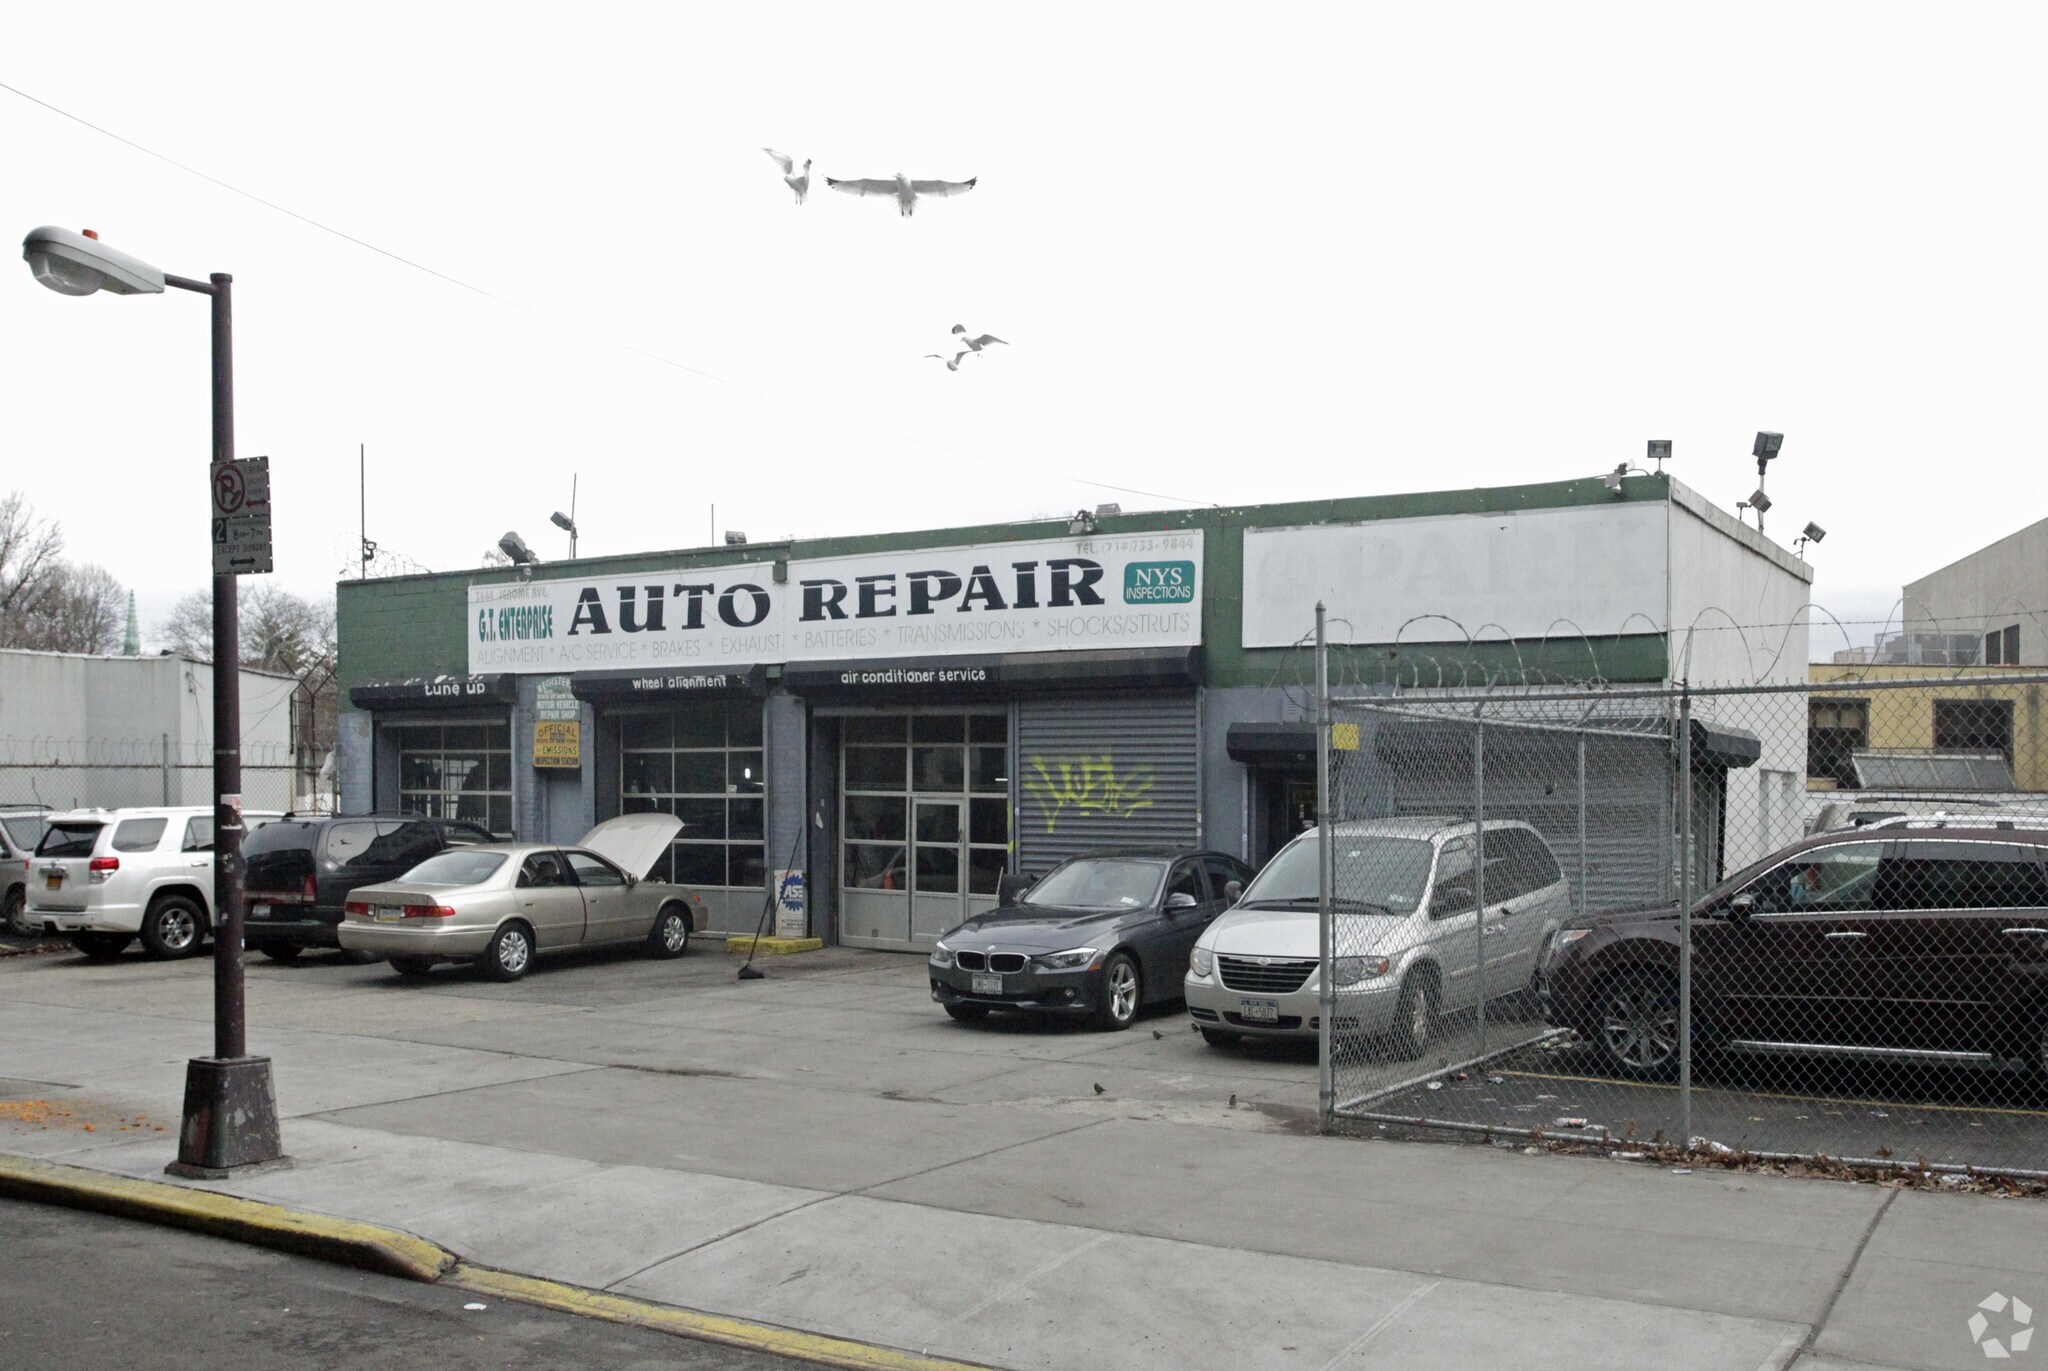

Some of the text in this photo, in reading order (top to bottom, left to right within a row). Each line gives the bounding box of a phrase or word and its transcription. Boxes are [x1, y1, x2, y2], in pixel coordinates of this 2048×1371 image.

[1135, 567, 1183, 586] NYS
[499, 587, 530, 600] JEROME
[567, 558, 1105, 636] AUTO REPAIR
[1126, 585, 1191, 600] INSPECTIONS
[478, 605, 553, 642] G.T. ENTERPRISE
[477, 612, 1190, 665] ALIGNMENT A/C SERVICE BRAKES EXHAUST BATTERIES TRANSMISSIONS SHOCKS/STRUTS
[632, 675, 727, 689] wheel alignment
[841, 668, 986, 684] air conditioner service
[425, 682, 485, 696] tune up
[537, 676, 571, 693] REGISTER
[537, 700, 579, 709] MOTOR VEHICLE
[540, 710, 576, 719] REPAIR SHOP
[538, 723, 576, 737] OFFICIAL
[543, 746, 577, 755] EMISSIONS
